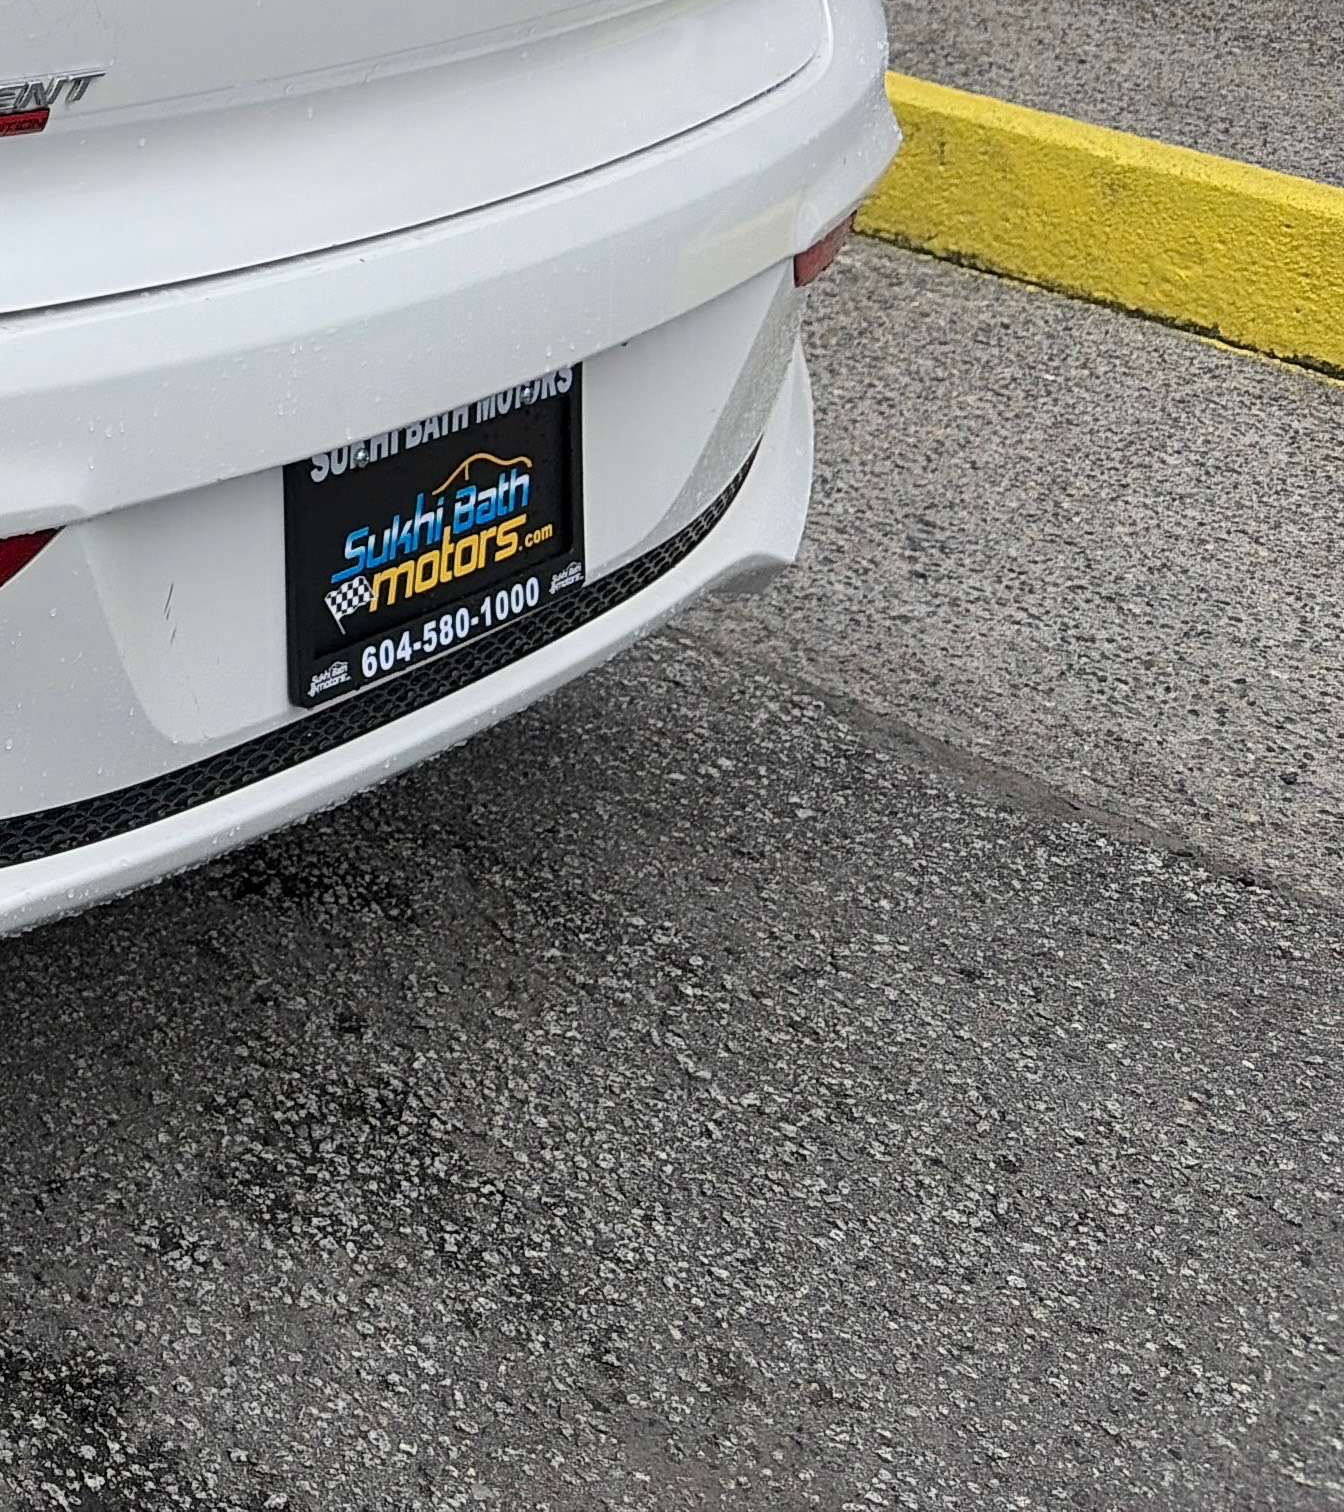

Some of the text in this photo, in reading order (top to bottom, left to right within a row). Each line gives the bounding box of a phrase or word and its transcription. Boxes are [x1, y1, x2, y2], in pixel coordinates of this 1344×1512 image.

[330, 467, 531, 585] Sukhi Bath
[361, 576, 540, 679] 604-580-1000
